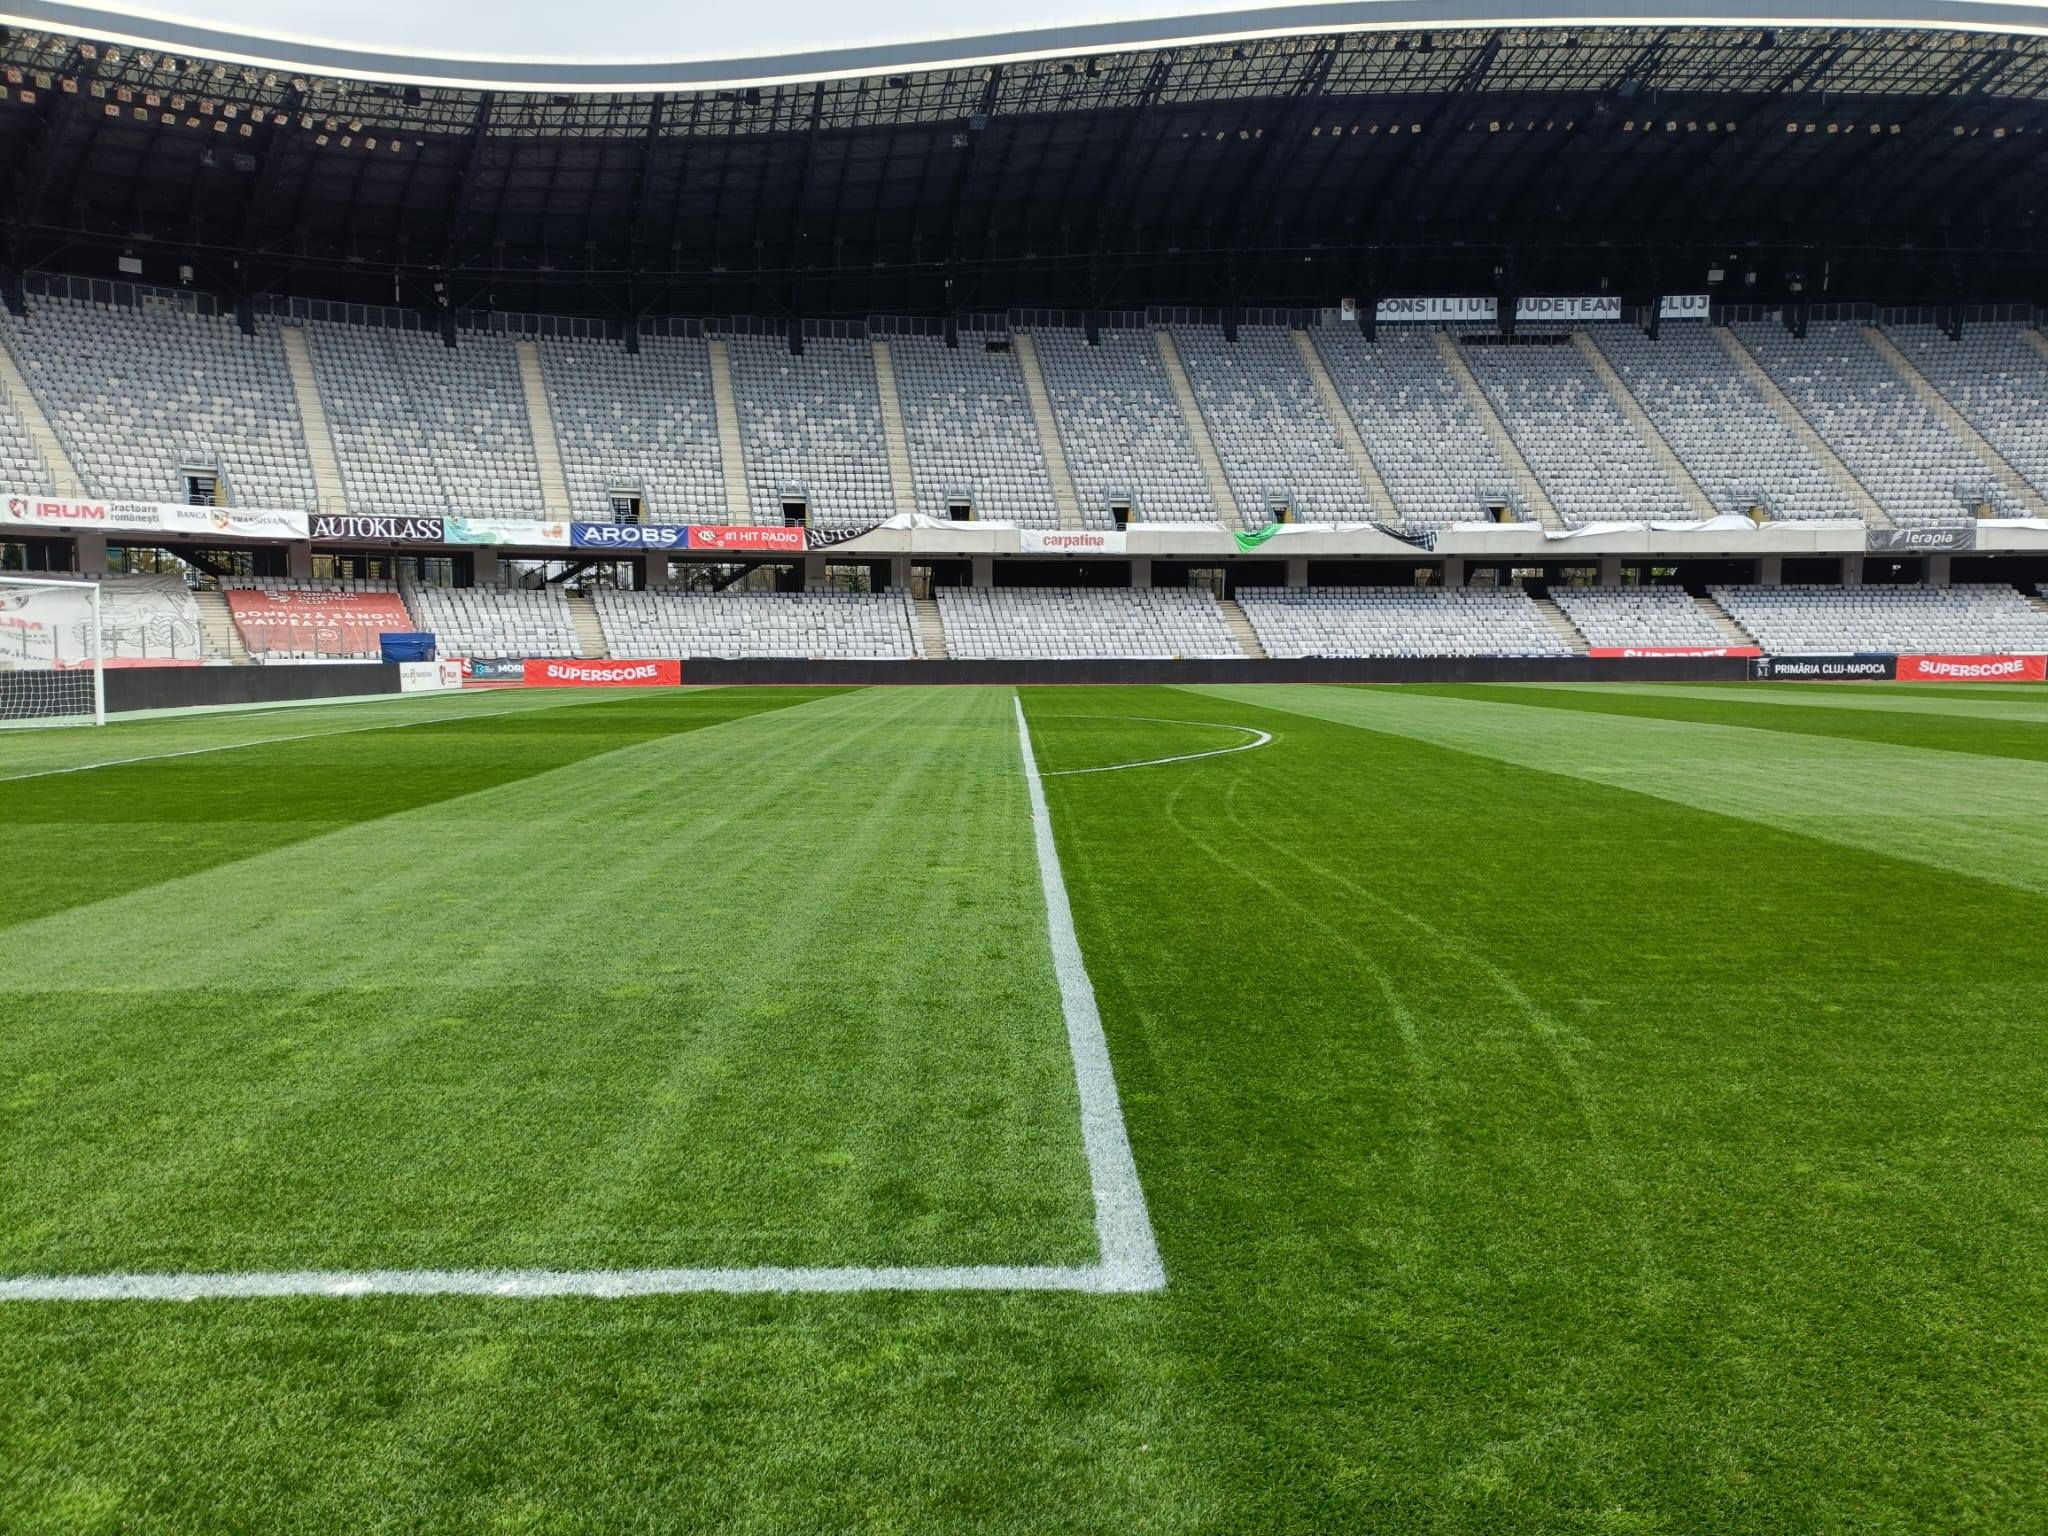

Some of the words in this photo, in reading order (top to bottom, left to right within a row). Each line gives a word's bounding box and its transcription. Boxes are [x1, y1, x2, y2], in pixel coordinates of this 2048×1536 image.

[1376, 299, 1495, 313] CONSILIUL
[36, 502, 105, 520] IRUM
[109, 502, 158, 514] Tractoare
[177, 510, 207, 520] BANCA
[312, 516, 442, 539] AUTOKLASS
[583, 527, 678, 543] AROBS
[725, 531, 737, 541] #1
[740, 531, 755, 541] HIT
[761, 531, 798, 543] RADIO
[1043, 533, 1104, 548] carpatina
[1905, 529, 1953, 545] Terapia
[546, 664, 658, 681] SUPERSCORE
[1775, 662, 1820, 674] PRIMĂRIA
[1822, 663, 1886, 674] CLUJ-NAPOCA
[1918, 659, 2024, 676] SUPERSCORE
